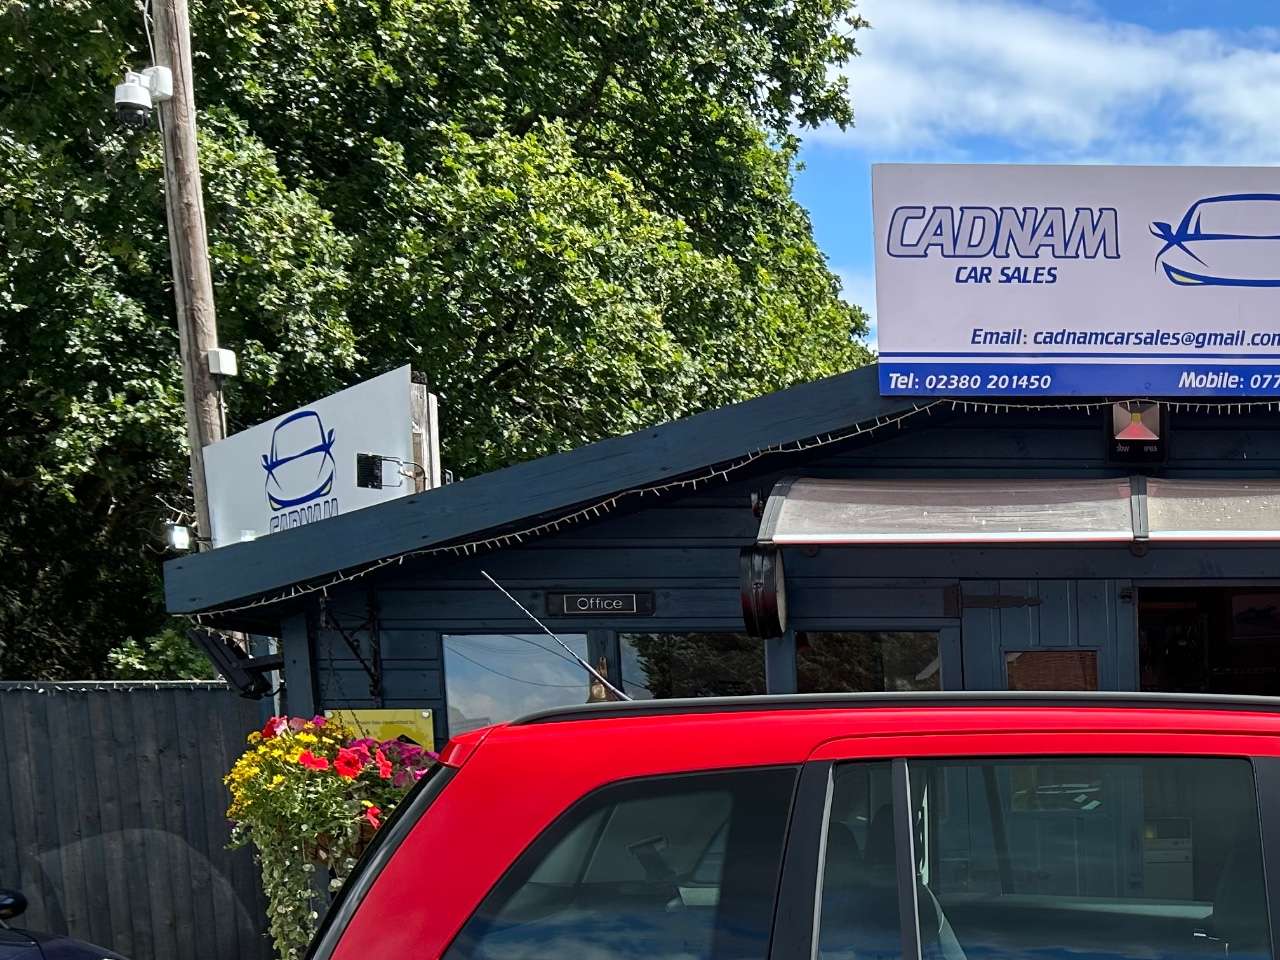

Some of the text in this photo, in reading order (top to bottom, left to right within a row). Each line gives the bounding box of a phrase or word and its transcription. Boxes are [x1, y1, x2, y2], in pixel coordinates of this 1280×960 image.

[887, 205, 1120, 259] CADNAM
[955, 266, 1058, 284] CAR SALES
[970, 328, 1027, 346] Email:
[889, 372, 1052, 389] Tel: 02380 201450
[1178, 371, 1244, 389] Mobile:
[576, 597, 623, 610] Office
